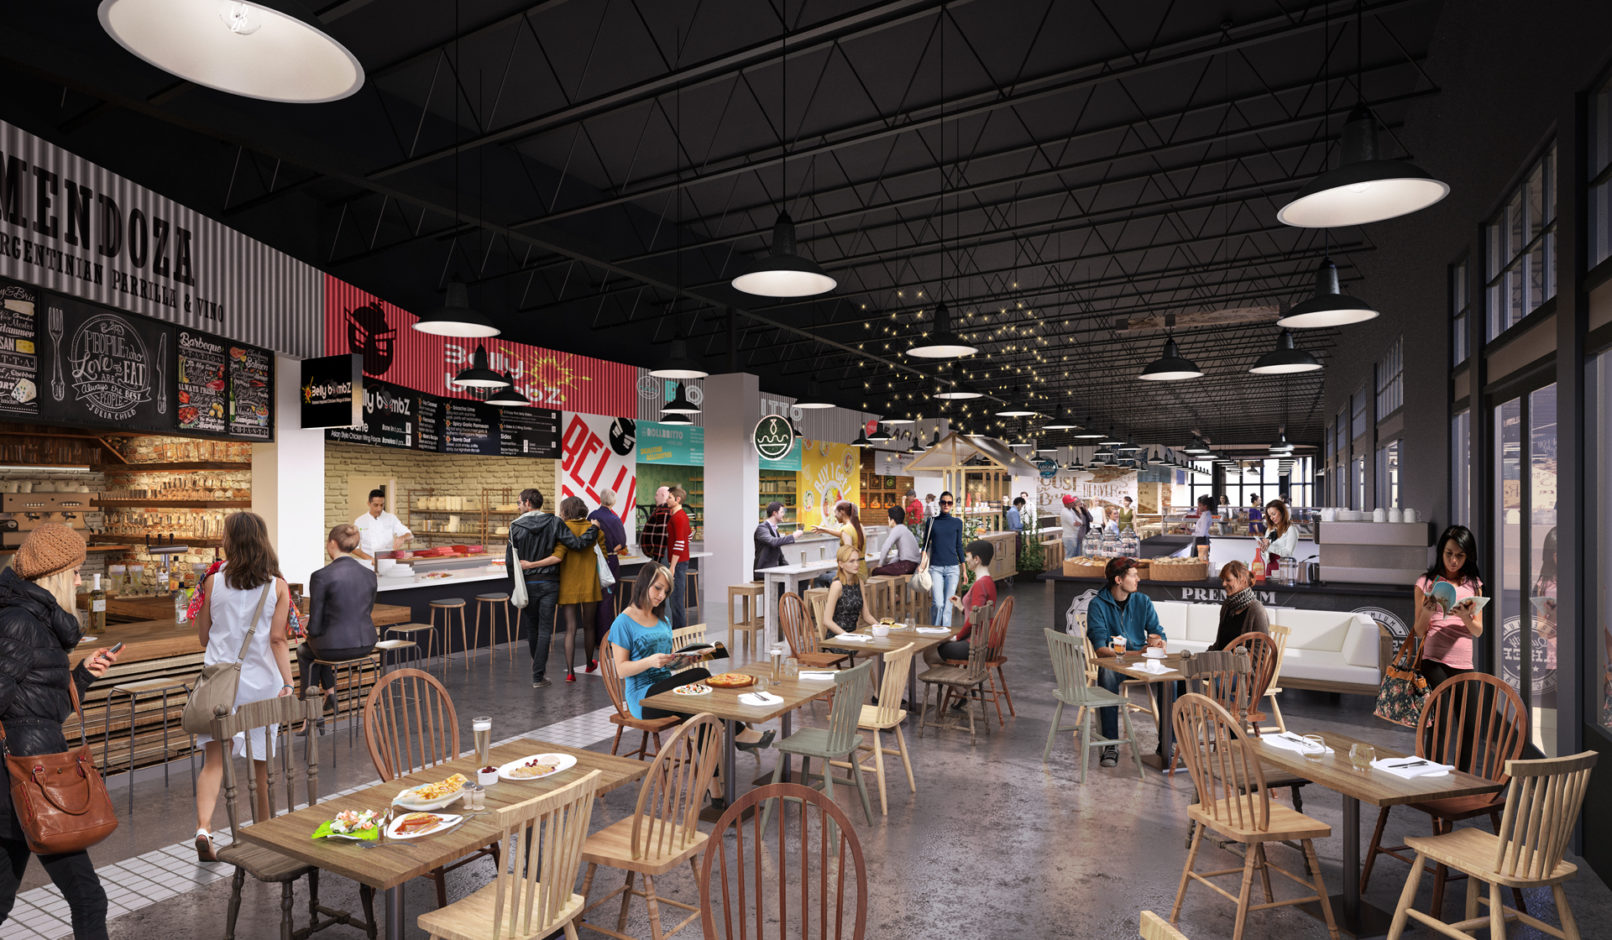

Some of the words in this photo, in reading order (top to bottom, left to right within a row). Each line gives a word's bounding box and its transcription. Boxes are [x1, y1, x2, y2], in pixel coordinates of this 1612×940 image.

[0, 150, 194, 287] MENDOZA
[112, 269, 177, 309] PARRILLA
[184, 293, 192, 313] &
[196, 297, 224, 322] VINO
[84, 329, 126, 358] PEOPLE
[123, 360, 145, 386] EAT
[124, 389, 142, 401] BEST
[311, 384, 327, 400] Belly
[114, 408, 137, 420] CHILD
[814, 462, 830, 495] BUY
[1182, 586, 1277, 604] PREM
